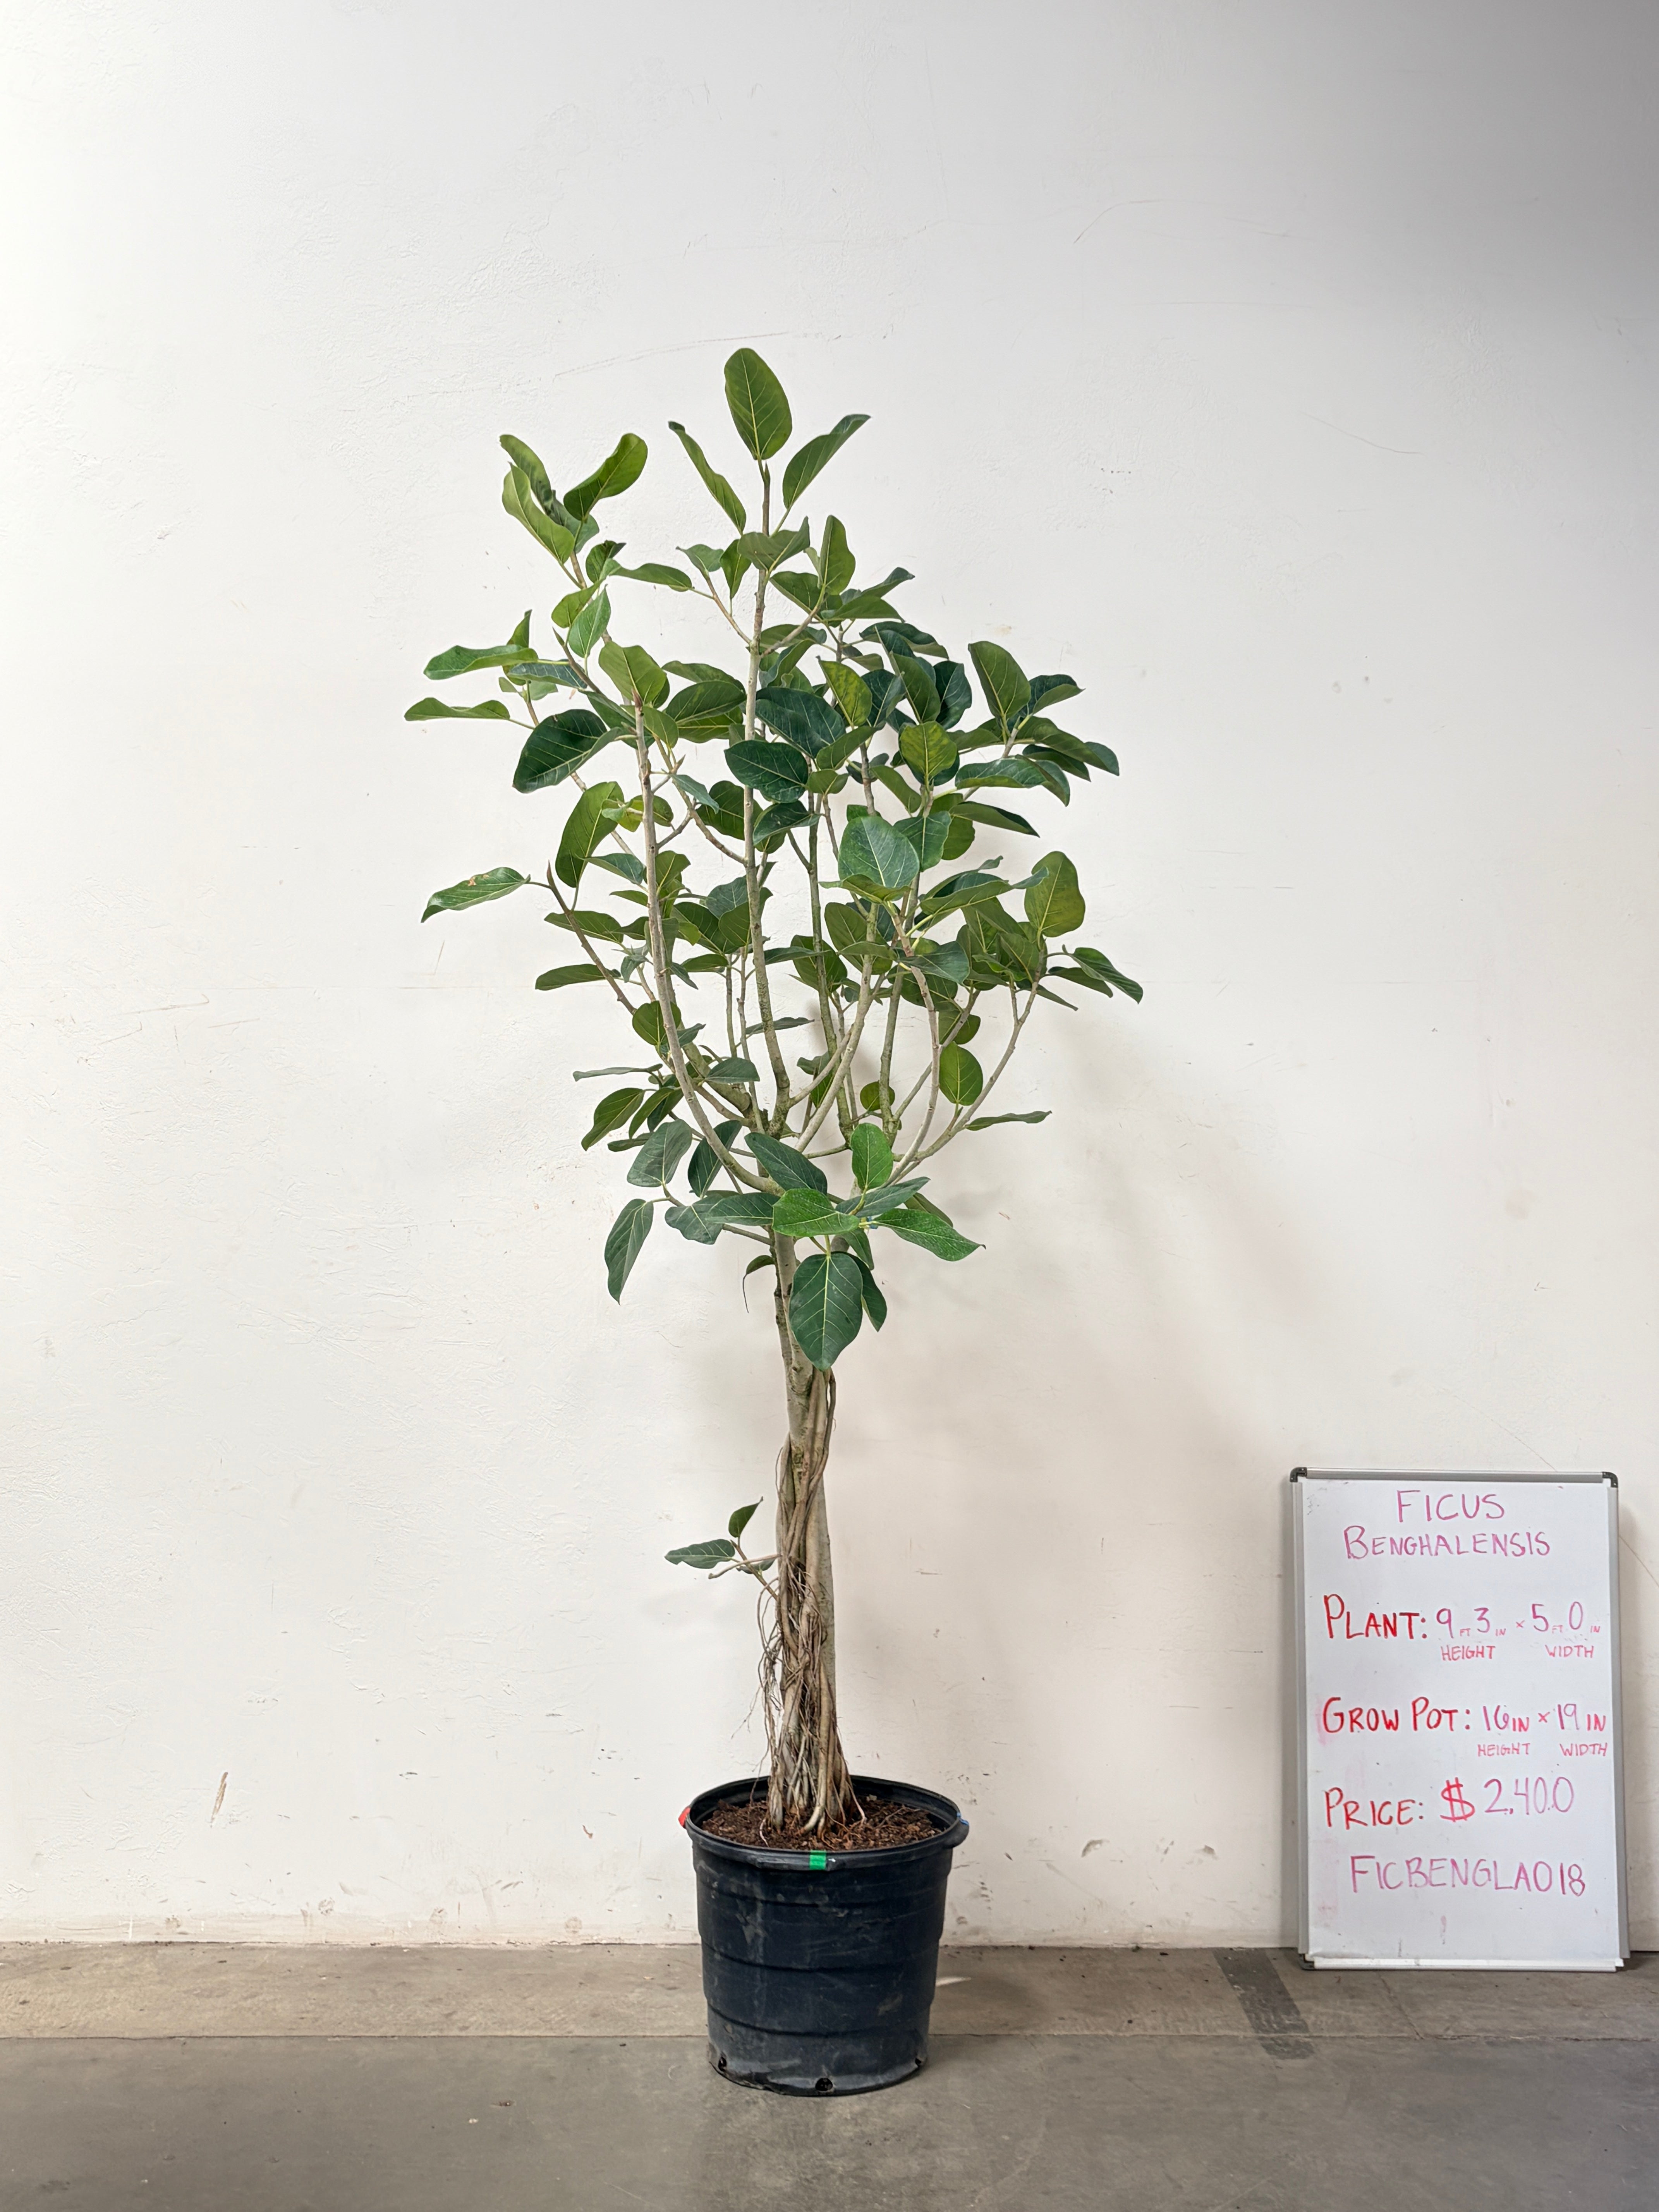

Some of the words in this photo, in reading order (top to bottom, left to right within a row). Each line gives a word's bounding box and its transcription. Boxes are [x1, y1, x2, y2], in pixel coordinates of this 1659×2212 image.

[1397, 1490, 1505, 1523] FICUS
[1343, 1525, 1550, 1559] BENGHALENSIS
[1323, 1594, 1427, 1640] PLANT:
[1440, 1645, 1496, 1661] HEIGHT
[1544, 1645, 1594, 1659] WIDTH
[1323, 1697, 1399, 1733] GROW
[1411, 1696, 1471, 1732] POT:
[1477, 1742, 1531, 1757] HEIGHT
[1559, 1743, 1608, 1757] WIDTH
[1324, 1787, 1424, 1830] PRICE:
